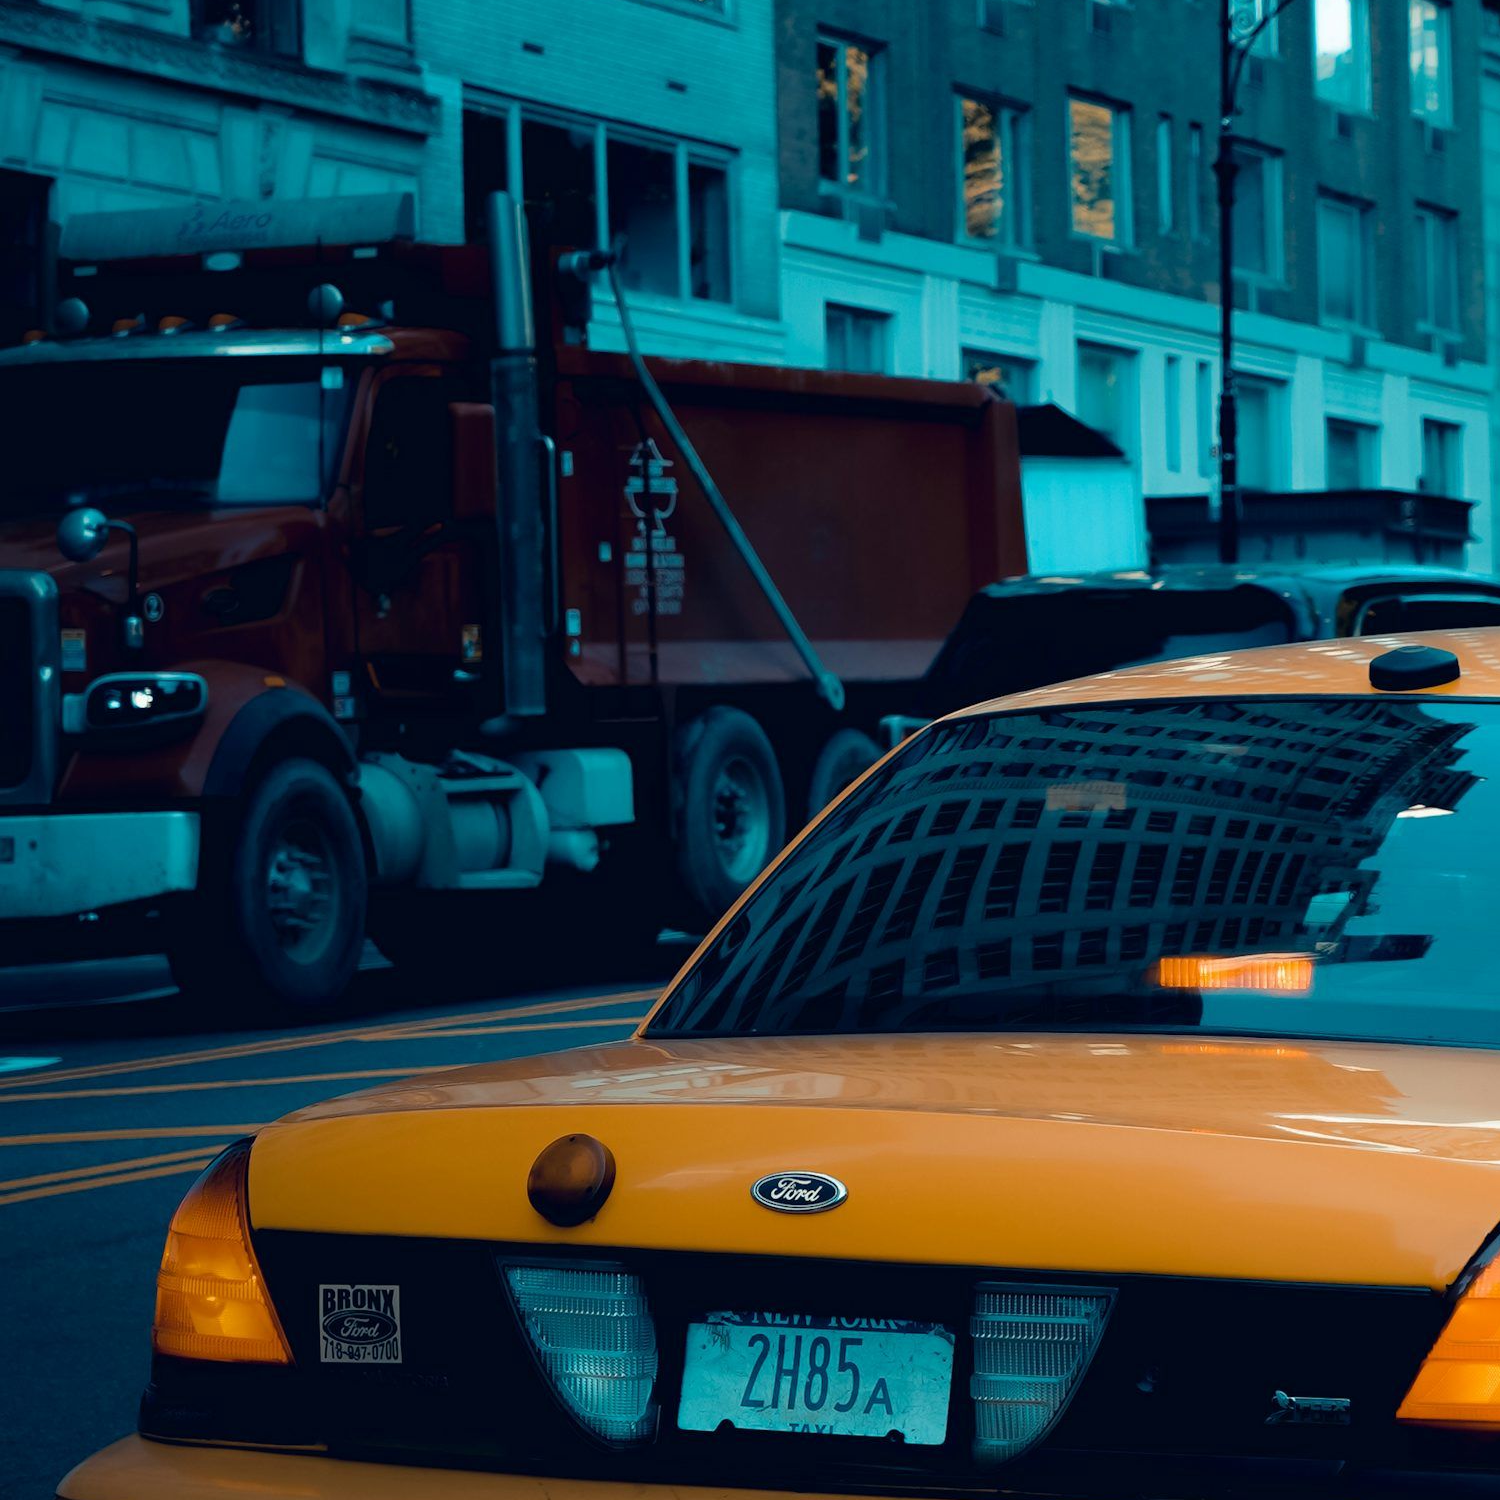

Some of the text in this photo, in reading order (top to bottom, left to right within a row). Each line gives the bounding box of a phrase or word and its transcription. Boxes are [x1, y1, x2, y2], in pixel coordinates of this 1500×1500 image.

[207, 209, 273, 232] Aero
[770, 1177, 823, 1202] Ford
[322, 1288, 396, 1320] BRONX
[340, 1316, 380, 1337] Ford
[788, 1423, 834, 1435] TAXI
